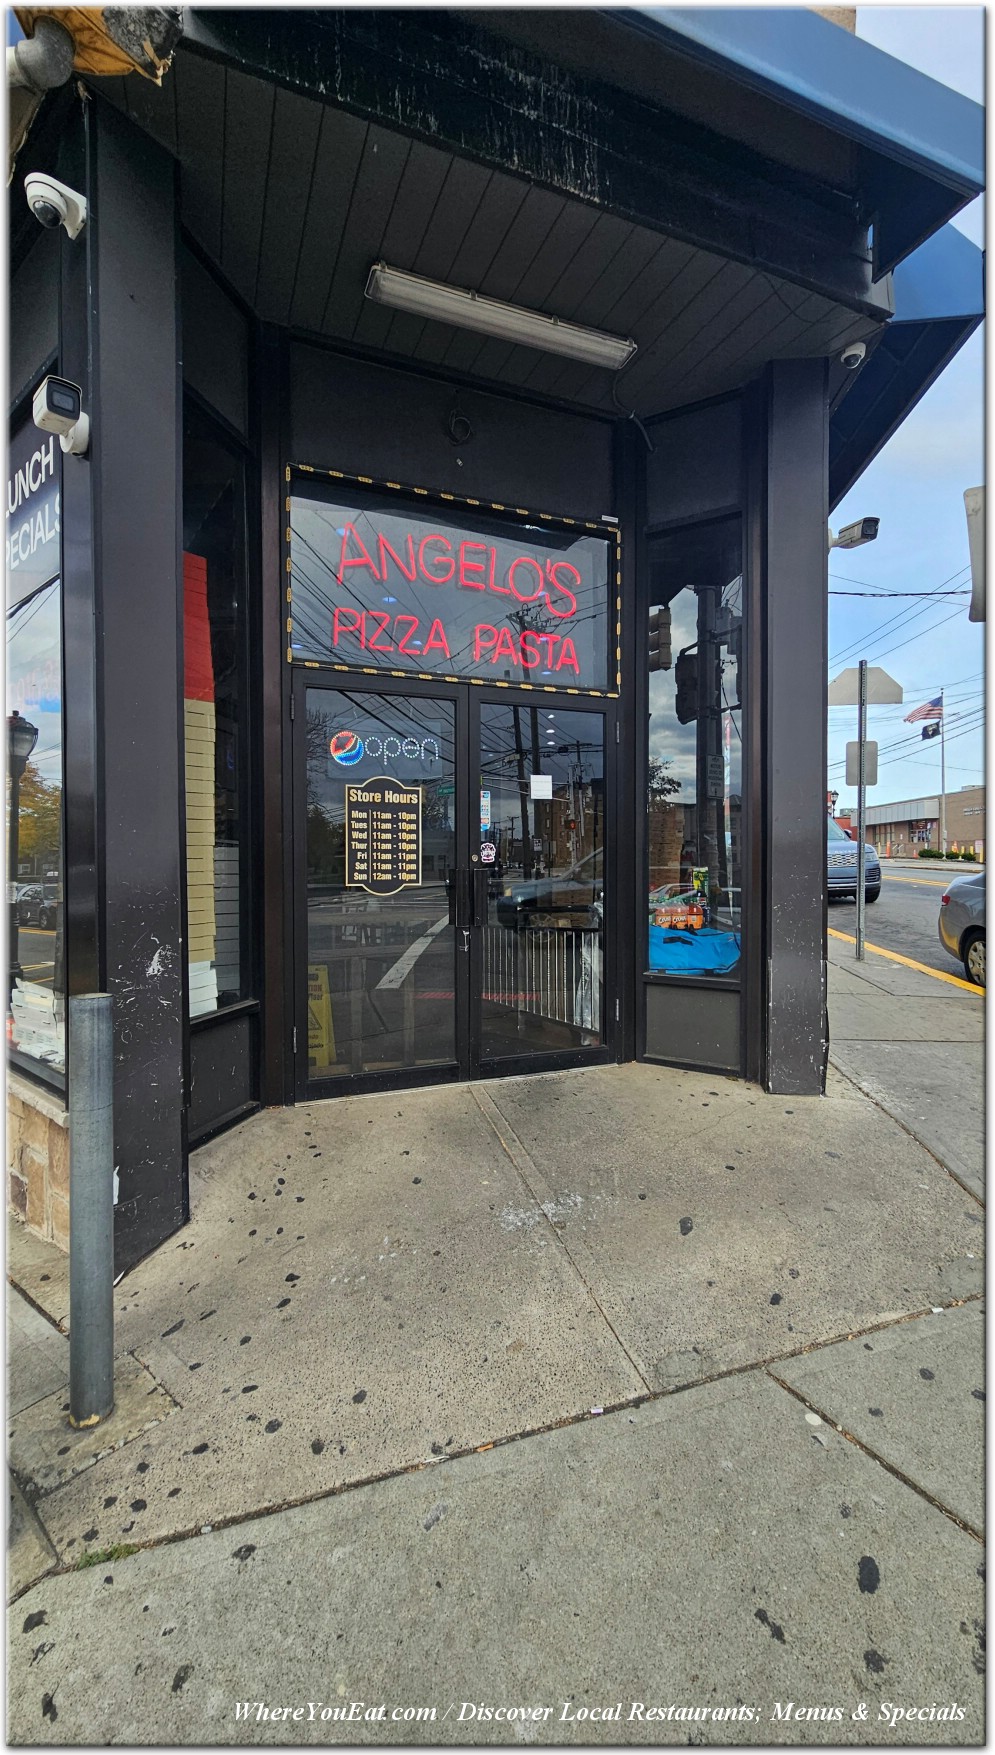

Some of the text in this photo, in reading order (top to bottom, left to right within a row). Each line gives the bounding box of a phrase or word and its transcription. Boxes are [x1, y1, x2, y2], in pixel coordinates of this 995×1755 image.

[6, 435, 54, 518] UNCH
[337, 522, 581, 618] ANGELO'S
[333, 608, 580, 675] PIZZA PASTA
[364, 736, 439, 765] open
[349, 788, 418, 804] Store Hours
[351, 811, 367, 819] Mon
[372, 811, 391, 819] 11am
[398, 811, 417, 821] 10pm
[350, 821, 367, 829] Tues
[372, 821, 391, 830] 11am
[398, 821, 417, 831] 10pm
[351, 831, 367, 839] Wed
[372, 831, 391, 840] 11am
[398, 831, 417, 841] 10pm
[351, 841, 367, 850] Thur
[372, 842, 391, 850] 11am
[398, 842, 417, 852] 10pm
[357, 851, 367, 860] Fri
[372, 852, 391, 860] 11am
[398, 852, 417, 861] 11pm
[355, 861, 367, 870] Sat
[372, 862, 391, 870] 11am
[398, 862, 417, 871] 11pm
[353, 872, 367, 880] Sun
[372, 872, 391, 880] 12am
[398, 872, 417, 881] 10pm
